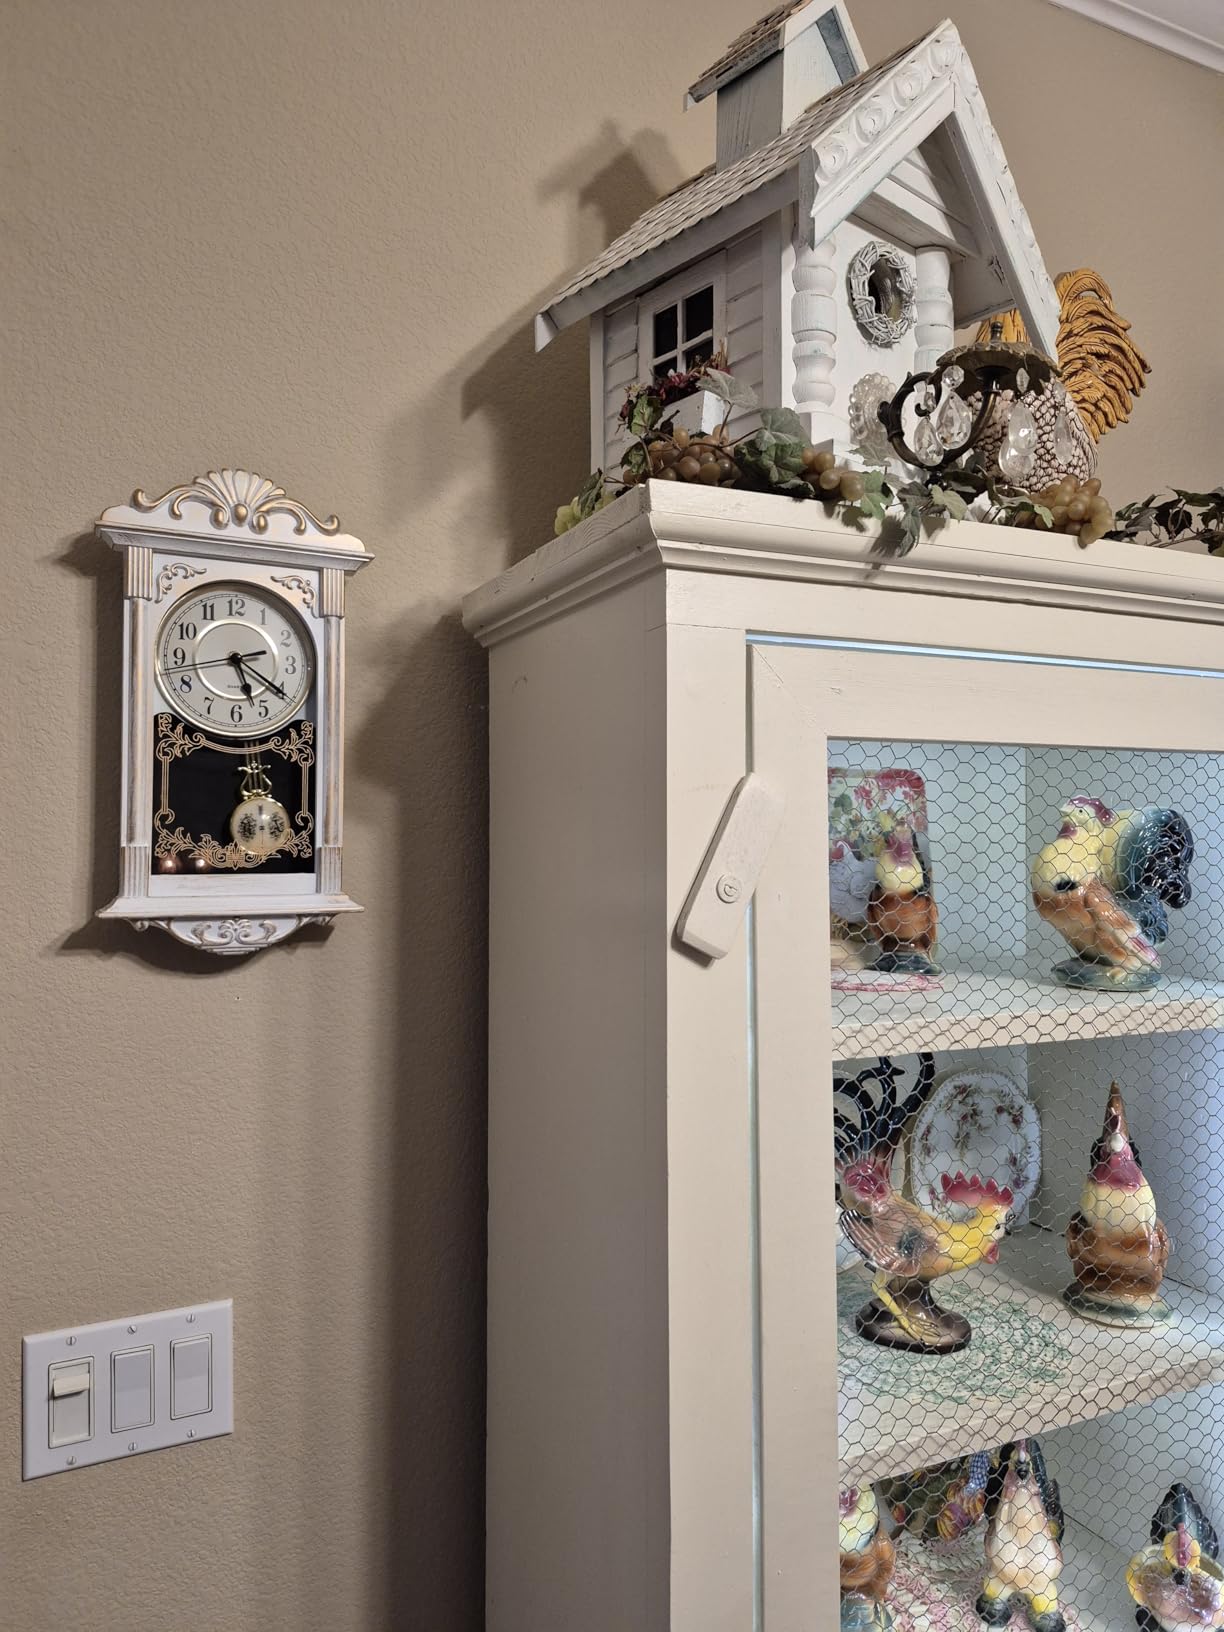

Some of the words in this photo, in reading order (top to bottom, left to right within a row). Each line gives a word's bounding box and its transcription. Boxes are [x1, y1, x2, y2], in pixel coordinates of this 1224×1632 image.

[201, 602, 216, 621] 11
[227, 598, 245, 617] 12
[260, 607, 267, 625] 1
[178, 622, 197, 640] 10
[280, 629, 292, 647] 2
[173, 647, 186, 666] 9
[285, 656, 296, 675] 3
[179, 674, 192, 693] 8
[203, 696, 214, 715] 7
[230, 704, 243, 723] 6
[258, 699, 269, 718] 5
